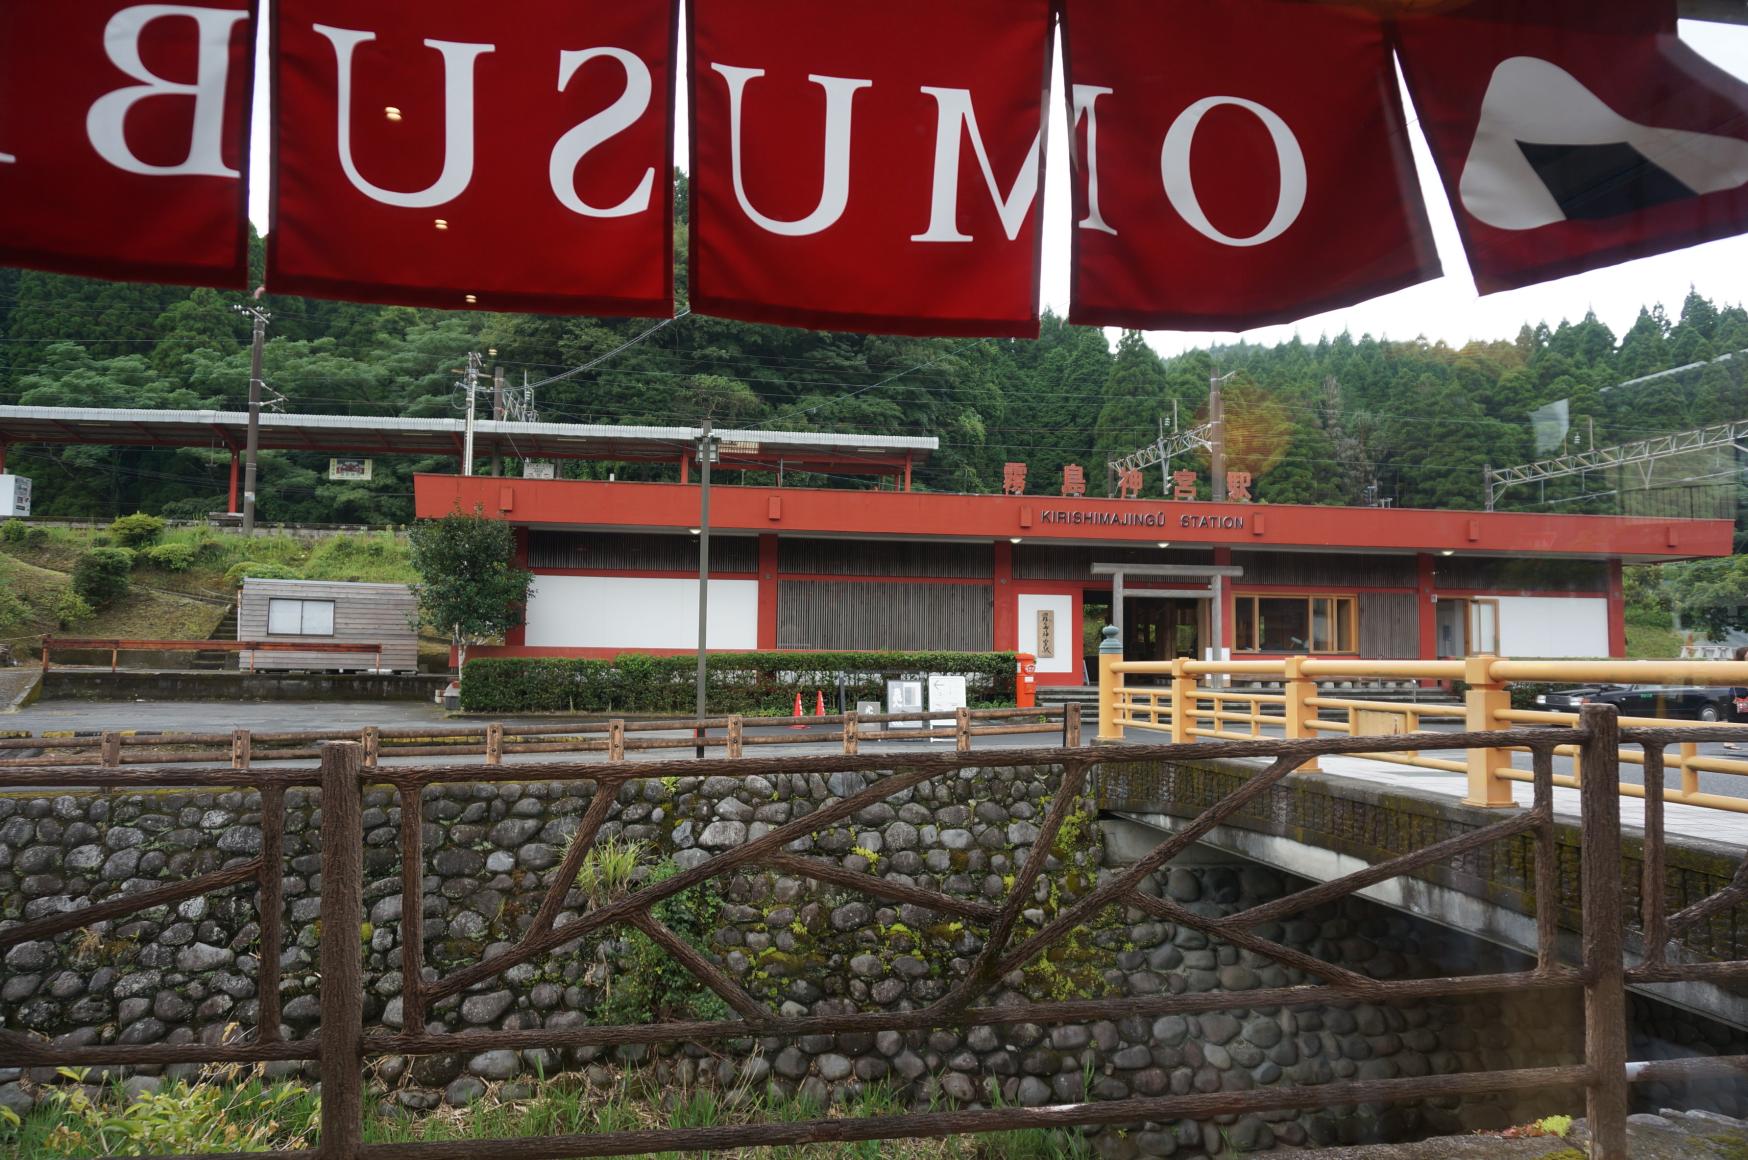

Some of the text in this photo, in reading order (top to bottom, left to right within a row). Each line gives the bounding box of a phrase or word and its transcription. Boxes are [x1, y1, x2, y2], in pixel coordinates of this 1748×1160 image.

[1003, 462, 1252, 500] 霧島神宮駅
[1180, 513, 1244, 529] STATION
